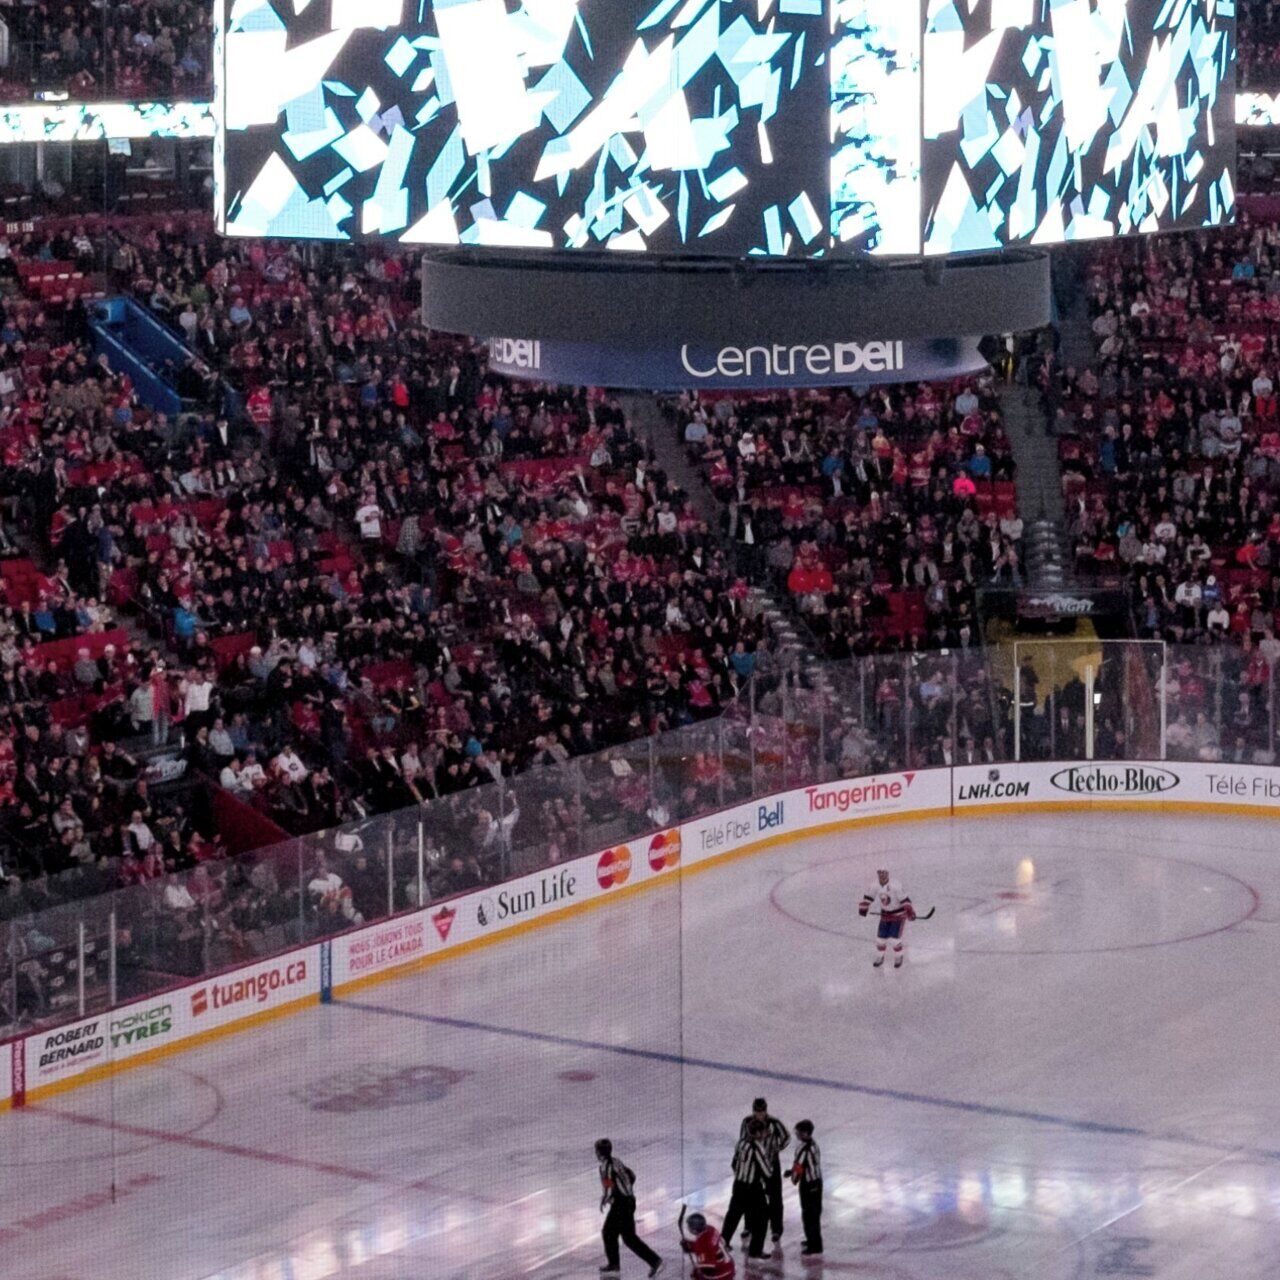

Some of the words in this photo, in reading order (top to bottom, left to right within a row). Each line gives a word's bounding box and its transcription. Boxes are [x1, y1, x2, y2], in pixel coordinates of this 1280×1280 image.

[805, 777, 902, 813] Tangerine
[958, 780, 1031, 801] LNH.COM
[1066, 767, 1166, 794] Techo-Bloc
[1206, 772, 1248, 797] Télé
[700, 823, 725, 851] Télé
[726, 818, 752, 842] Fibe
[758, 800, 785, 831] Bell
[496, 887, 536, 921] Sun
[540, 869, 577, 908] Life
[349, 952, 374, 972] POUR
[376, 948, 387, 965] LE
[389, 935, 424, 960] CANADA
[211, 961, 308, 1010] tuango.ca
[45, 1022, 100, 1051] ROBERT
[110, 1017, 172, 1049] TYRES
[38, 1036, 104, 1068] BERNARD
